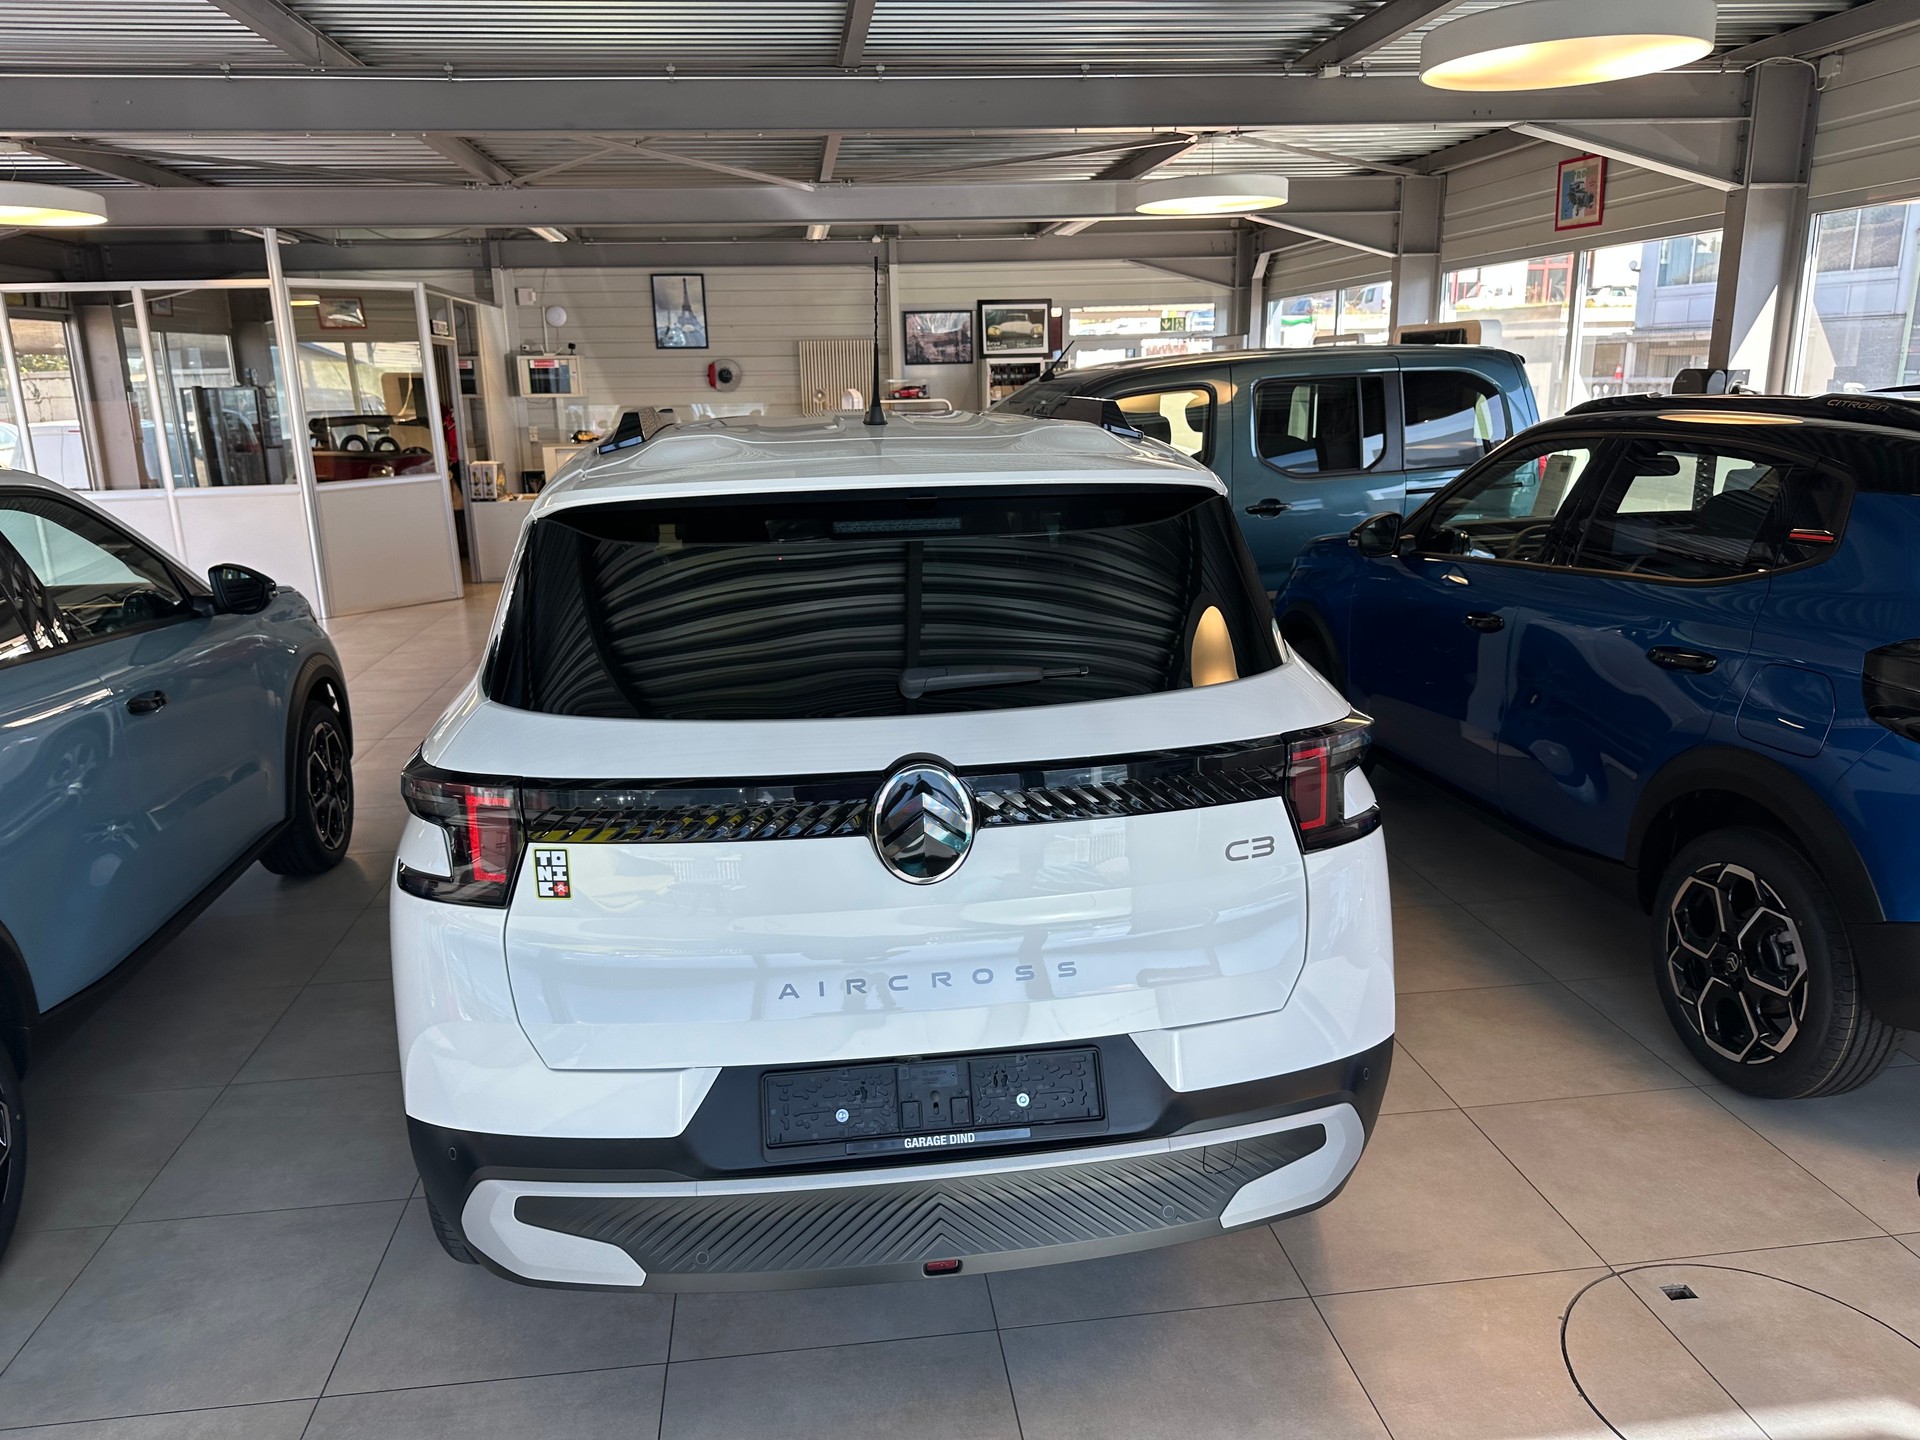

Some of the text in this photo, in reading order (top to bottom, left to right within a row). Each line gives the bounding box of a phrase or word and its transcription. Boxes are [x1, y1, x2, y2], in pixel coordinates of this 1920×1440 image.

[1225, 836, 1275, 861] C3
[778, 960, 1078, 1000] AIRCROSS
[904, 1132, 975, 1148] GARAGE DIND
